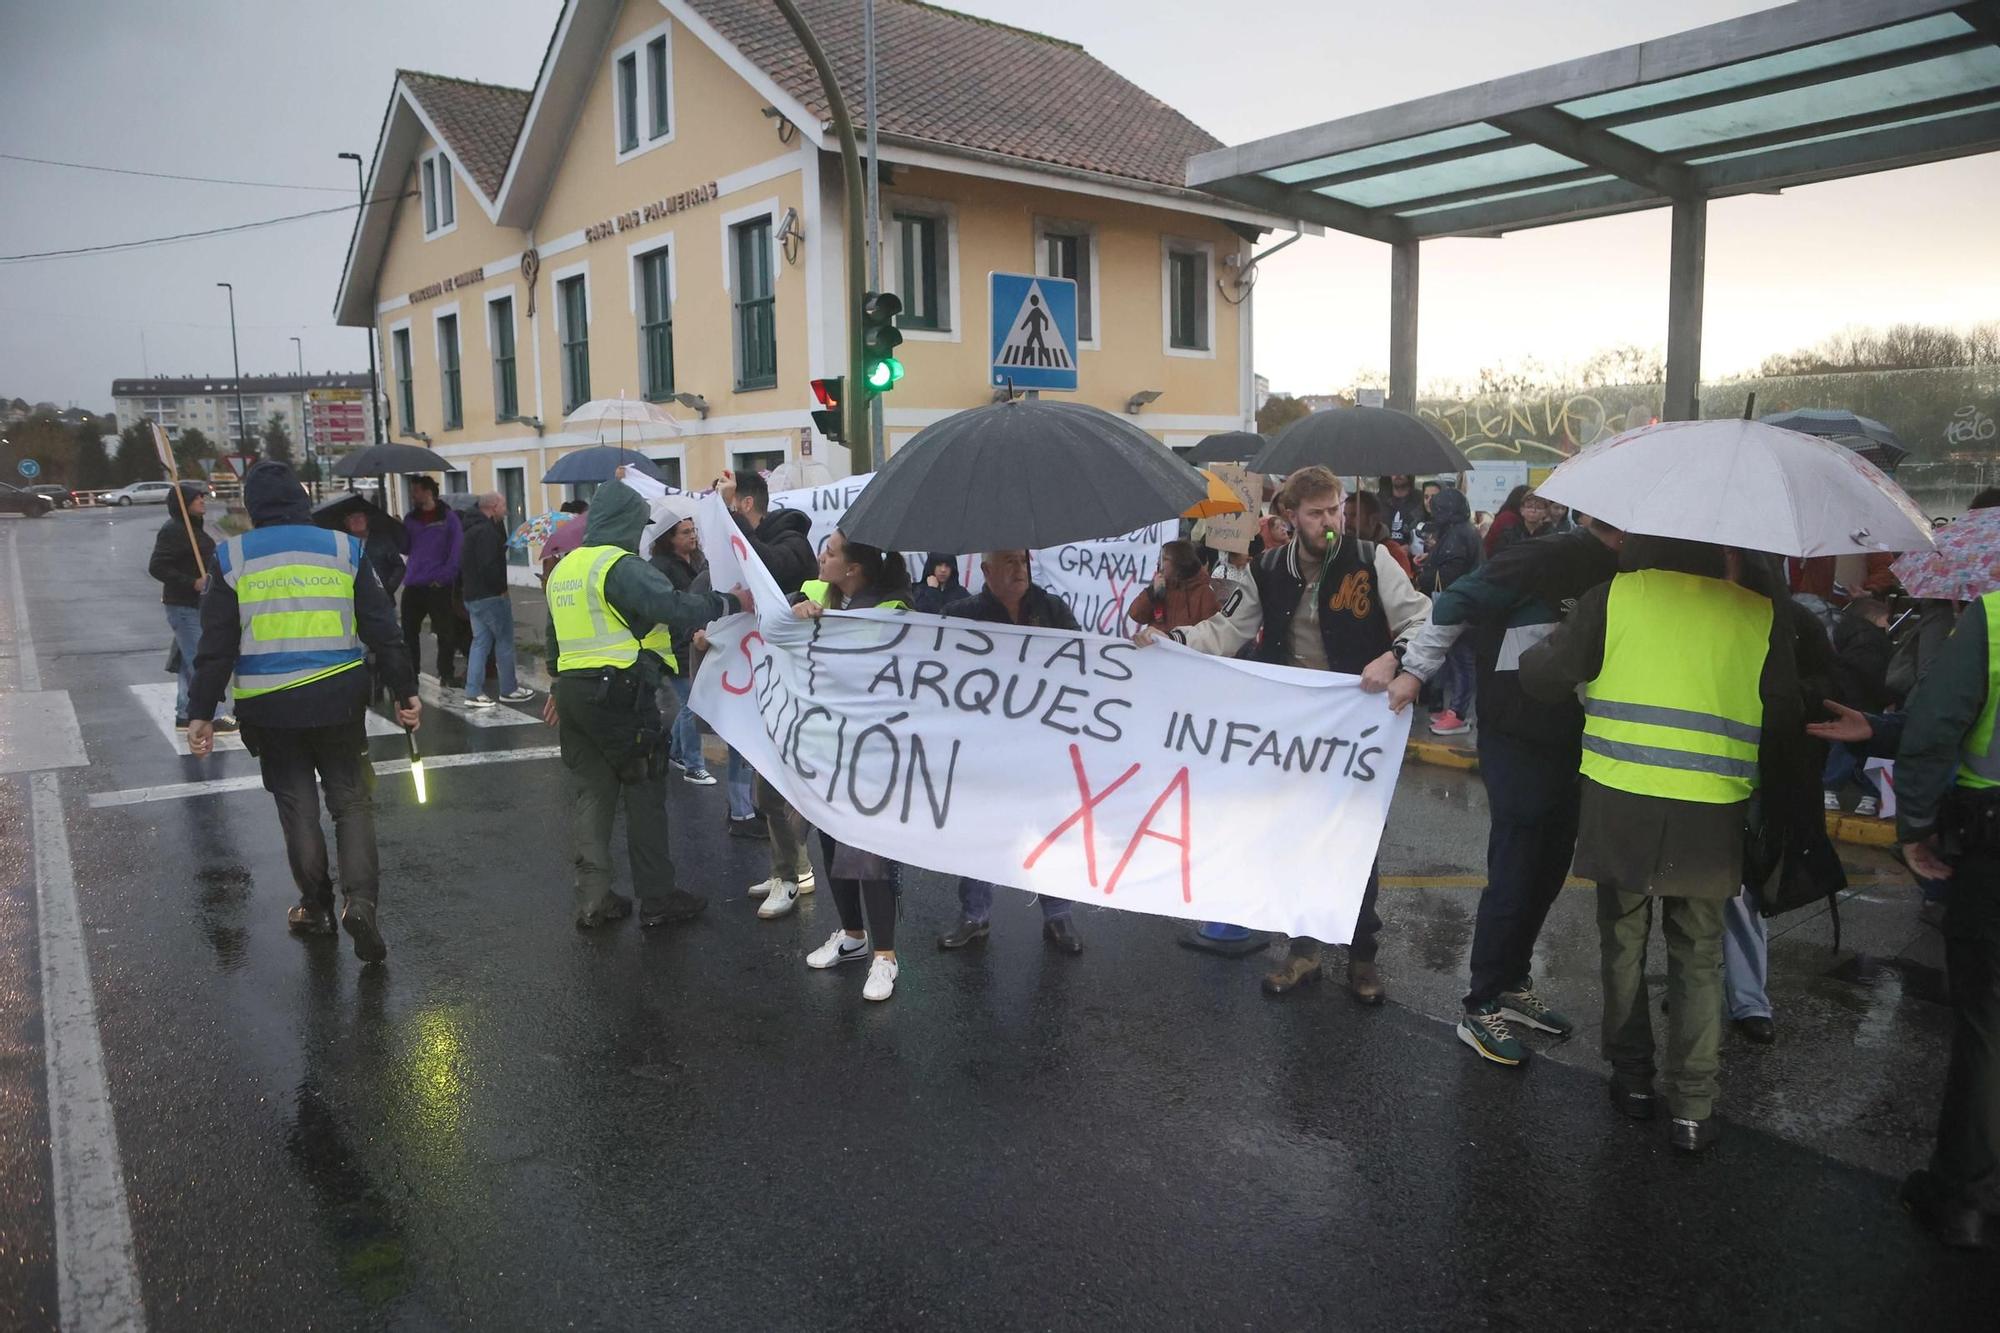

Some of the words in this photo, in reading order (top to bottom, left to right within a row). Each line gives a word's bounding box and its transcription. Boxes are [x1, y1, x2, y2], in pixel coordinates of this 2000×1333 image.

[585, 220, 615, 242] CASA
[617, 209, 641, 232] DAS
[643, 181, 719, 223] PALMEIRAS
[304, 576, 341, 586] LOCAL
[1059, 545, 1153, 585] GRAXAL
[553, 579, 583, 592] GUARDIA
[556, 594, 576, 607] CIVIL
[1163, 711, 1383, 782] INFANTÍS
[1023, 743, 1192, 904] XA
